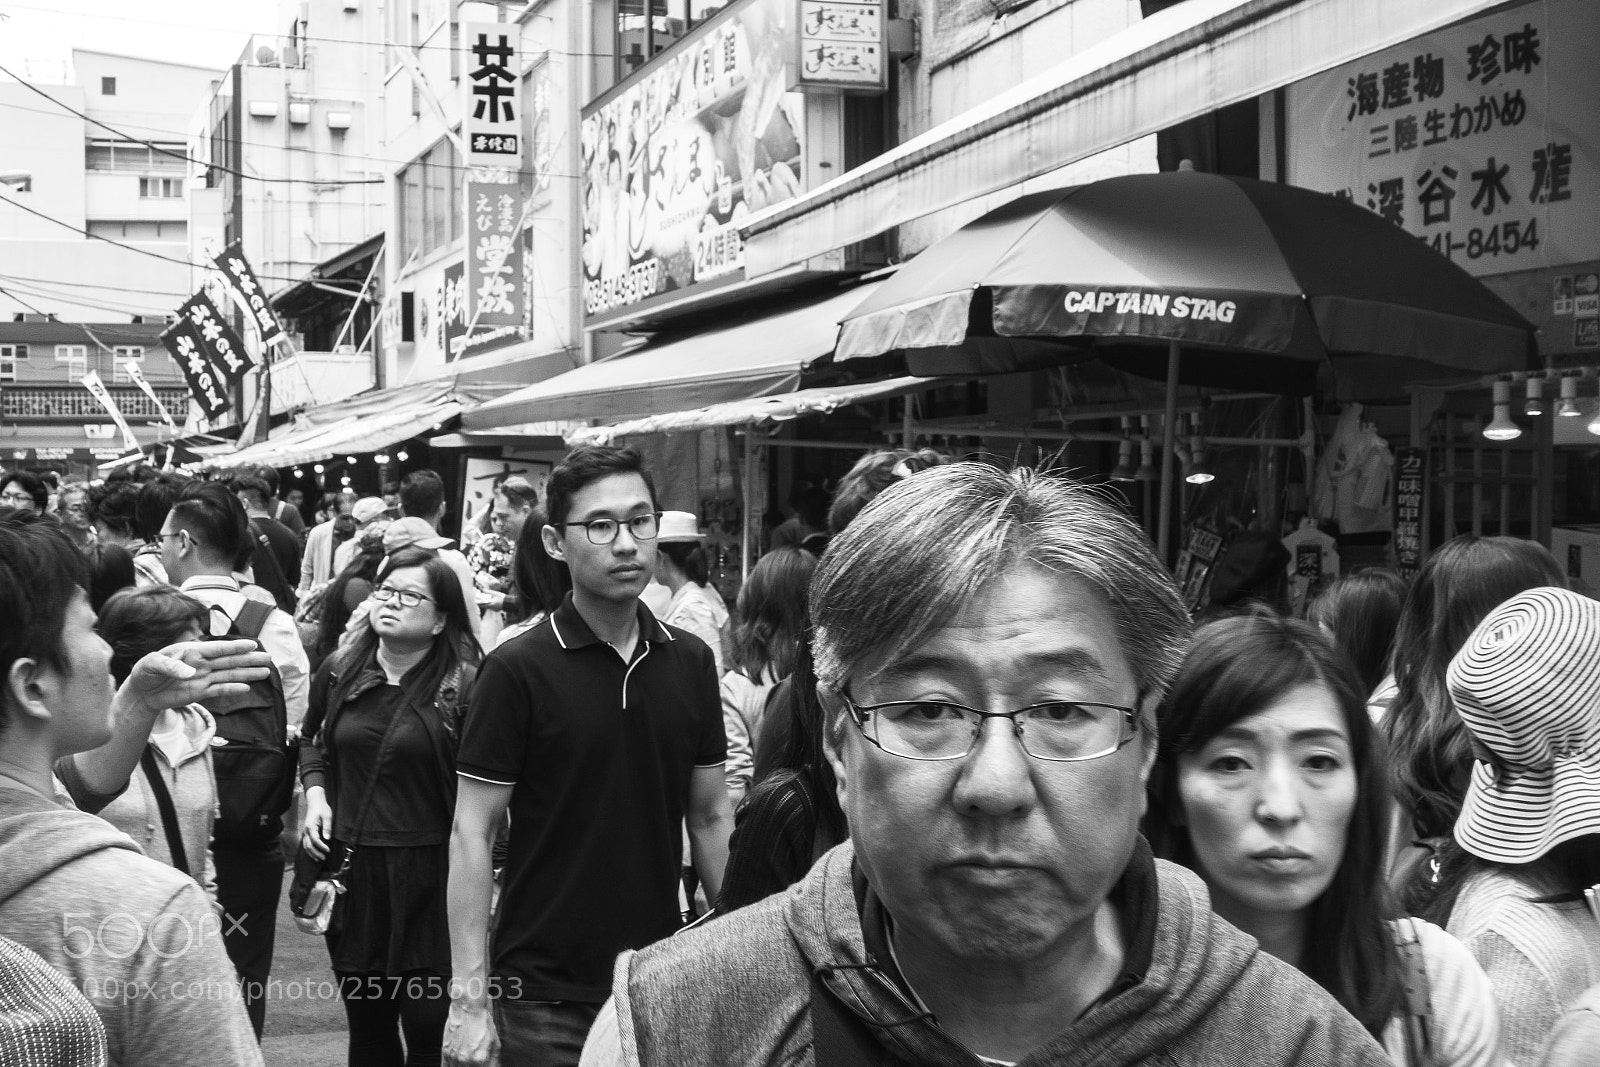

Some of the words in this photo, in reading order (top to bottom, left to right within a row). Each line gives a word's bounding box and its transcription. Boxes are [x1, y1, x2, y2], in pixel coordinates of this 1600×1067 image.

[469, 33, 517, 123] 茶
[1347, 53, 1445, 122] 海産物
[1467, 24, 1541, 85] 珍味
[1368, 89, 1526, 158] 三陸生わかめ
[476, 193, 493, 232] えび
[1328, 143, 1572, 227] 深谷水産
[1418, 217, 1540, 260] 41-8454
[1064, 290, 1170, 317] CAPTAIN
[1170, 295, 1237, 323] STAG
